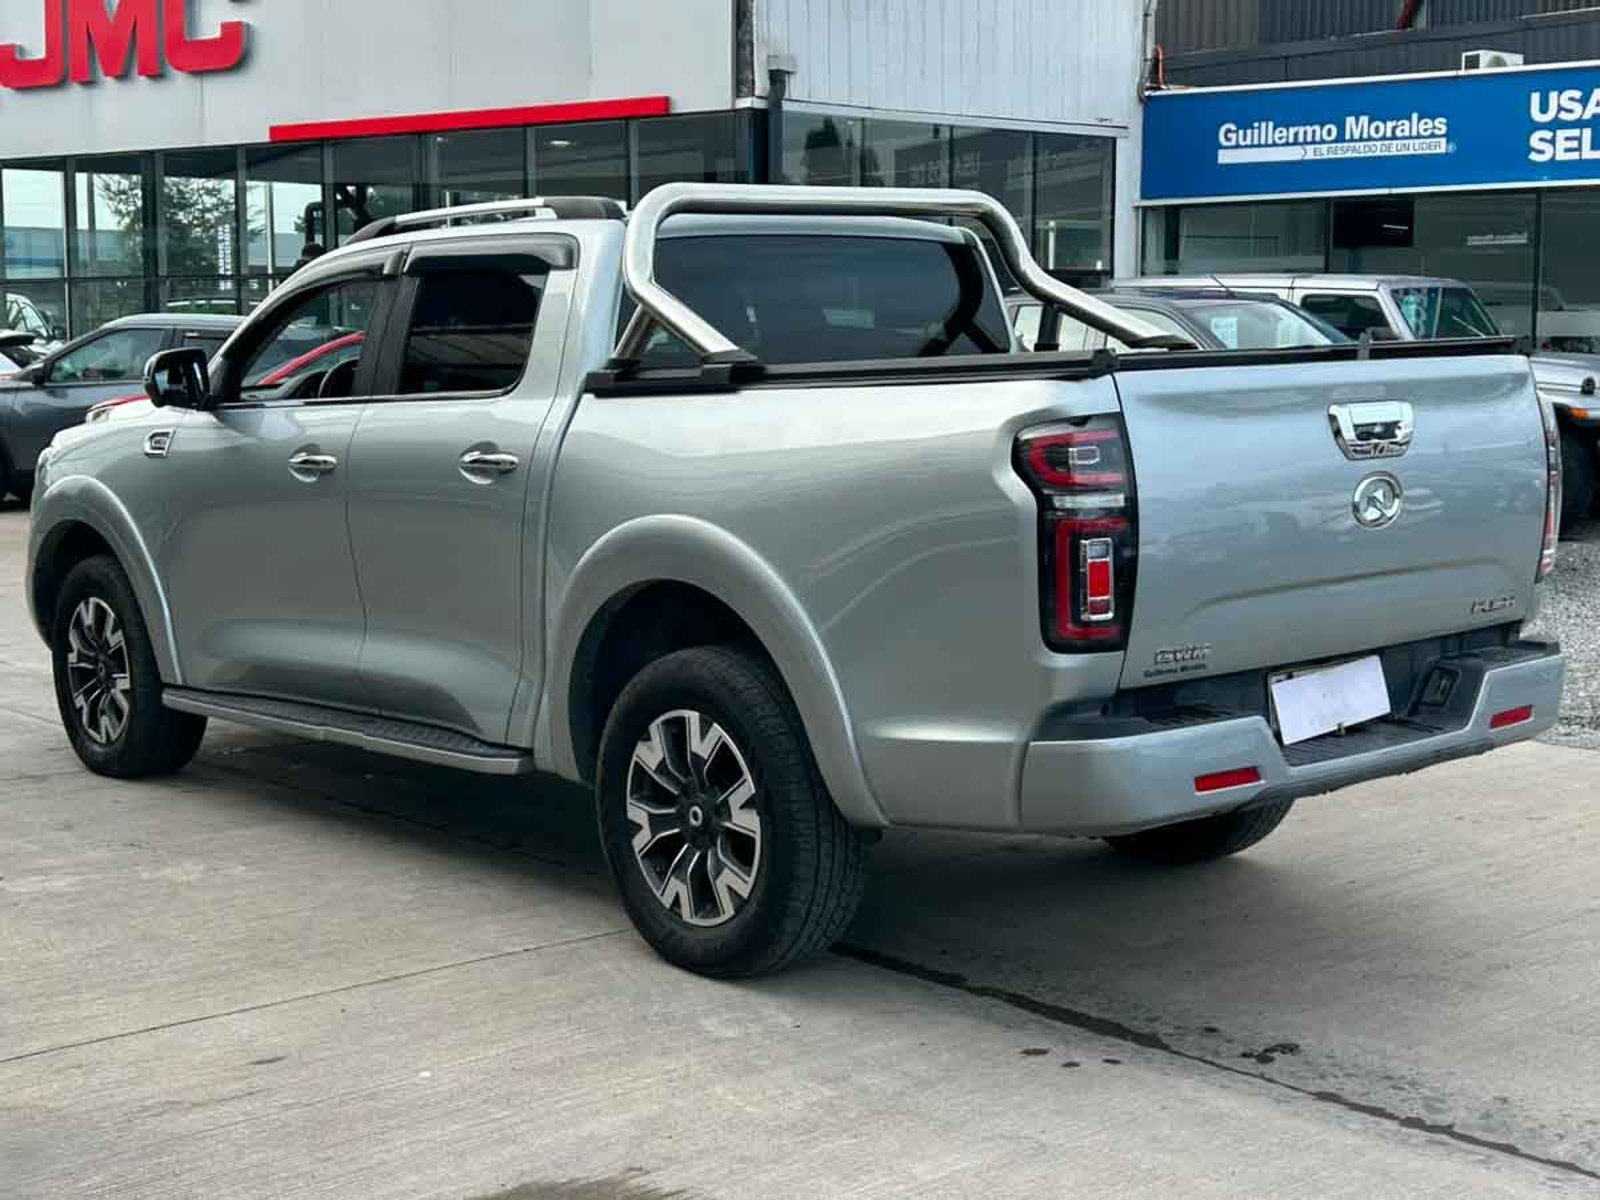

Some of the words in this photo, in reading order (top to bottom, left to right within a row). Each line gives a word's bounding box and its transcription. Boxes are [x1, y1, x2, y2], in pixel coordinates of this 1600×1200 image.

[0, 0, 245, 89] JMC
[1529, 88, 1600, 122] USA
[1218, 121, 1337, 146] Guillermo
[1344, 112, 1448, 140] Morales
[1528, 127, 1600, 162] SEL
[1312, 147, 1326, 157] EL
[1327, 143, 1378, 156] RESPALDO
[1379, 142, 1394, 153] DE
[1395, 141, 1411, 153] UN
